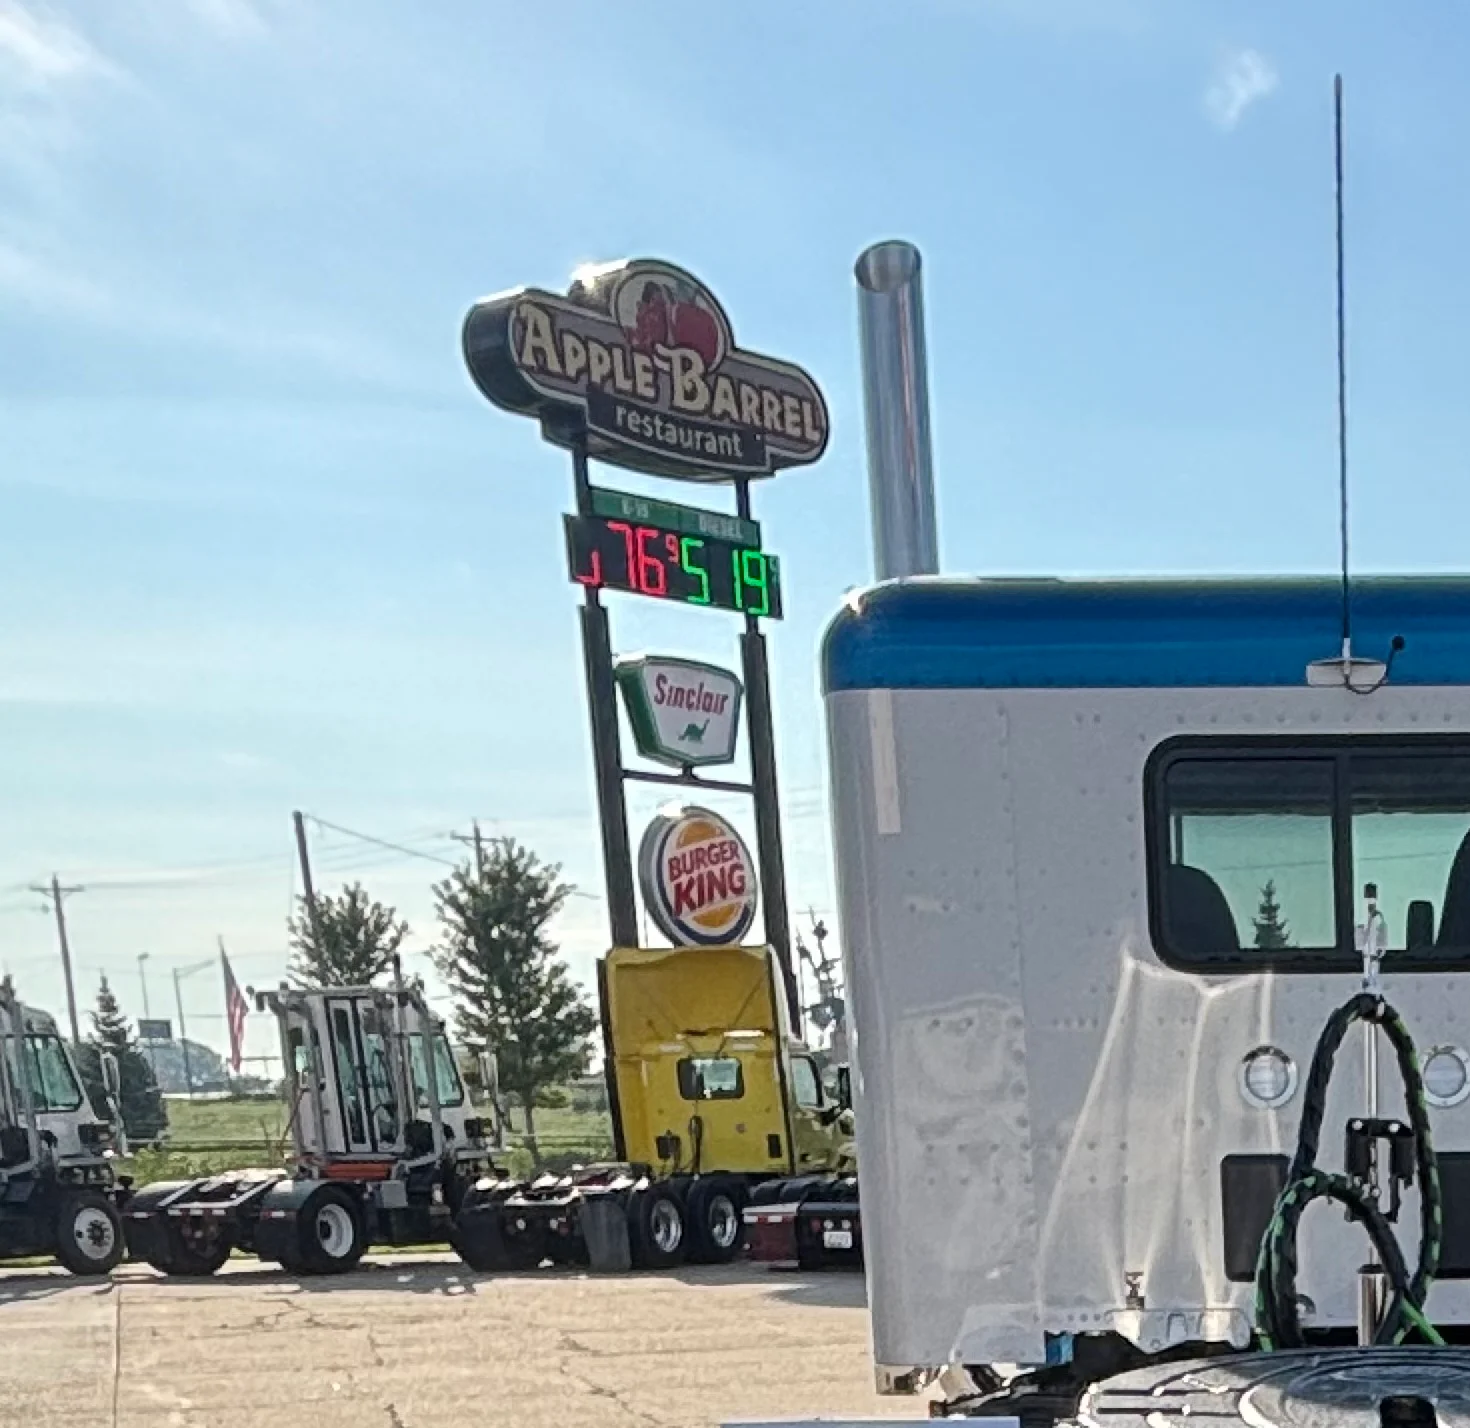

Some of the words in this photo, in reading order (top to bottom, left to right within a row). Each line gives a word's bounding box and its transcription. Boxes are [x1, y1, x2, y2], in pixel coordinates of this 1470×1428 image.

[517, 302, 657, 401] APPLE
[653, 343, 823, 443] BARREL
[615, 404, 743, 458] restaurant
[653, 672, 729, 716] Sinclair
[667, 839, 741, 882] BURGER
[673, 863, 746, 917] KING
